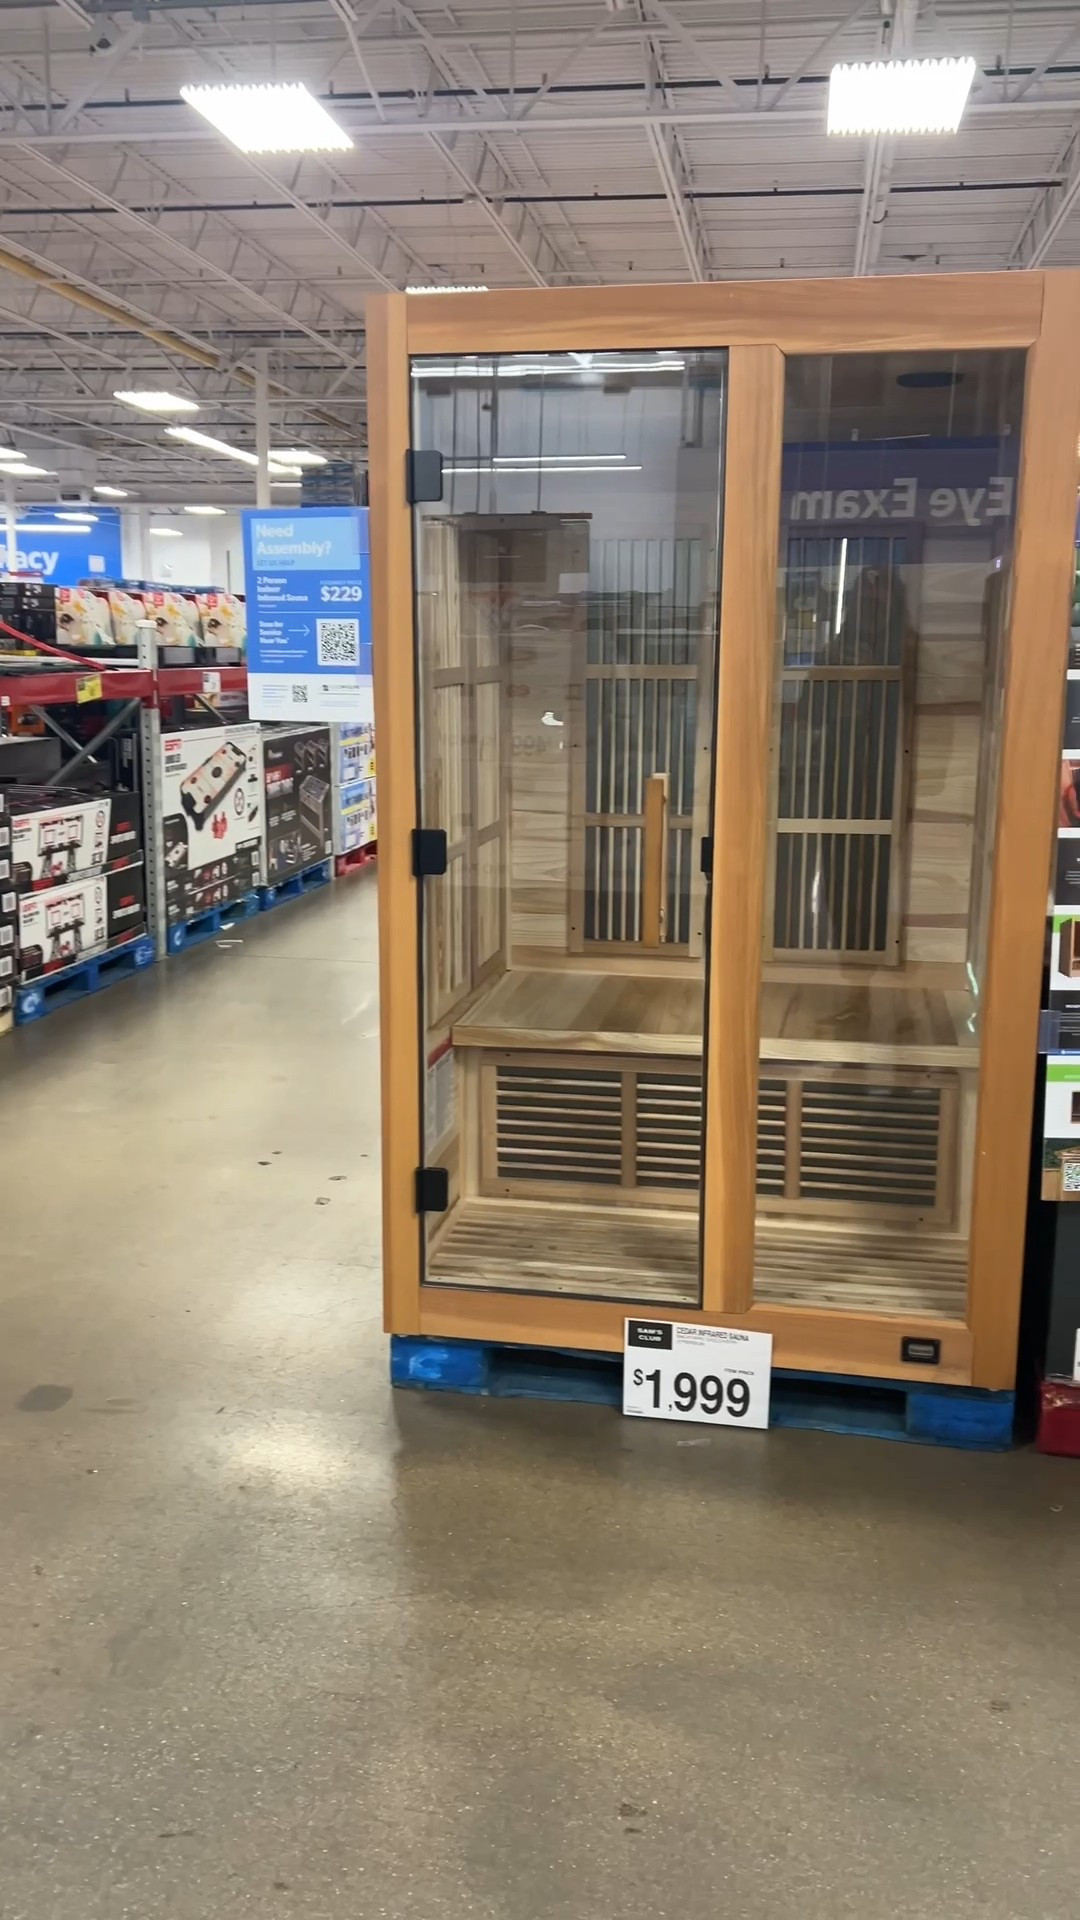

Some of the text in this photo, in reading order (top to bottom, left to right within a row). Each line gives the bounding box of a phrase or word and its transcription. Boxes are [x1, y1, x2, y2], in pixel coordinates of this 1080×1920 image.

[256, 524, 294, 537] Need
[257, 541, 332, 557] Assembly?
[320, 586, 363, 602] $229
[637, 1327, 663, 1335] SAM'S
[638, 1334, 662, 1342] CLUB
[676, 1326, 697, 1335] CEDAR
[698, 1329, 728, 1339] INFRARED
[729, 1332, 750, 1342] SAUNA
[633, 1368, 750, 1418] $1,999
